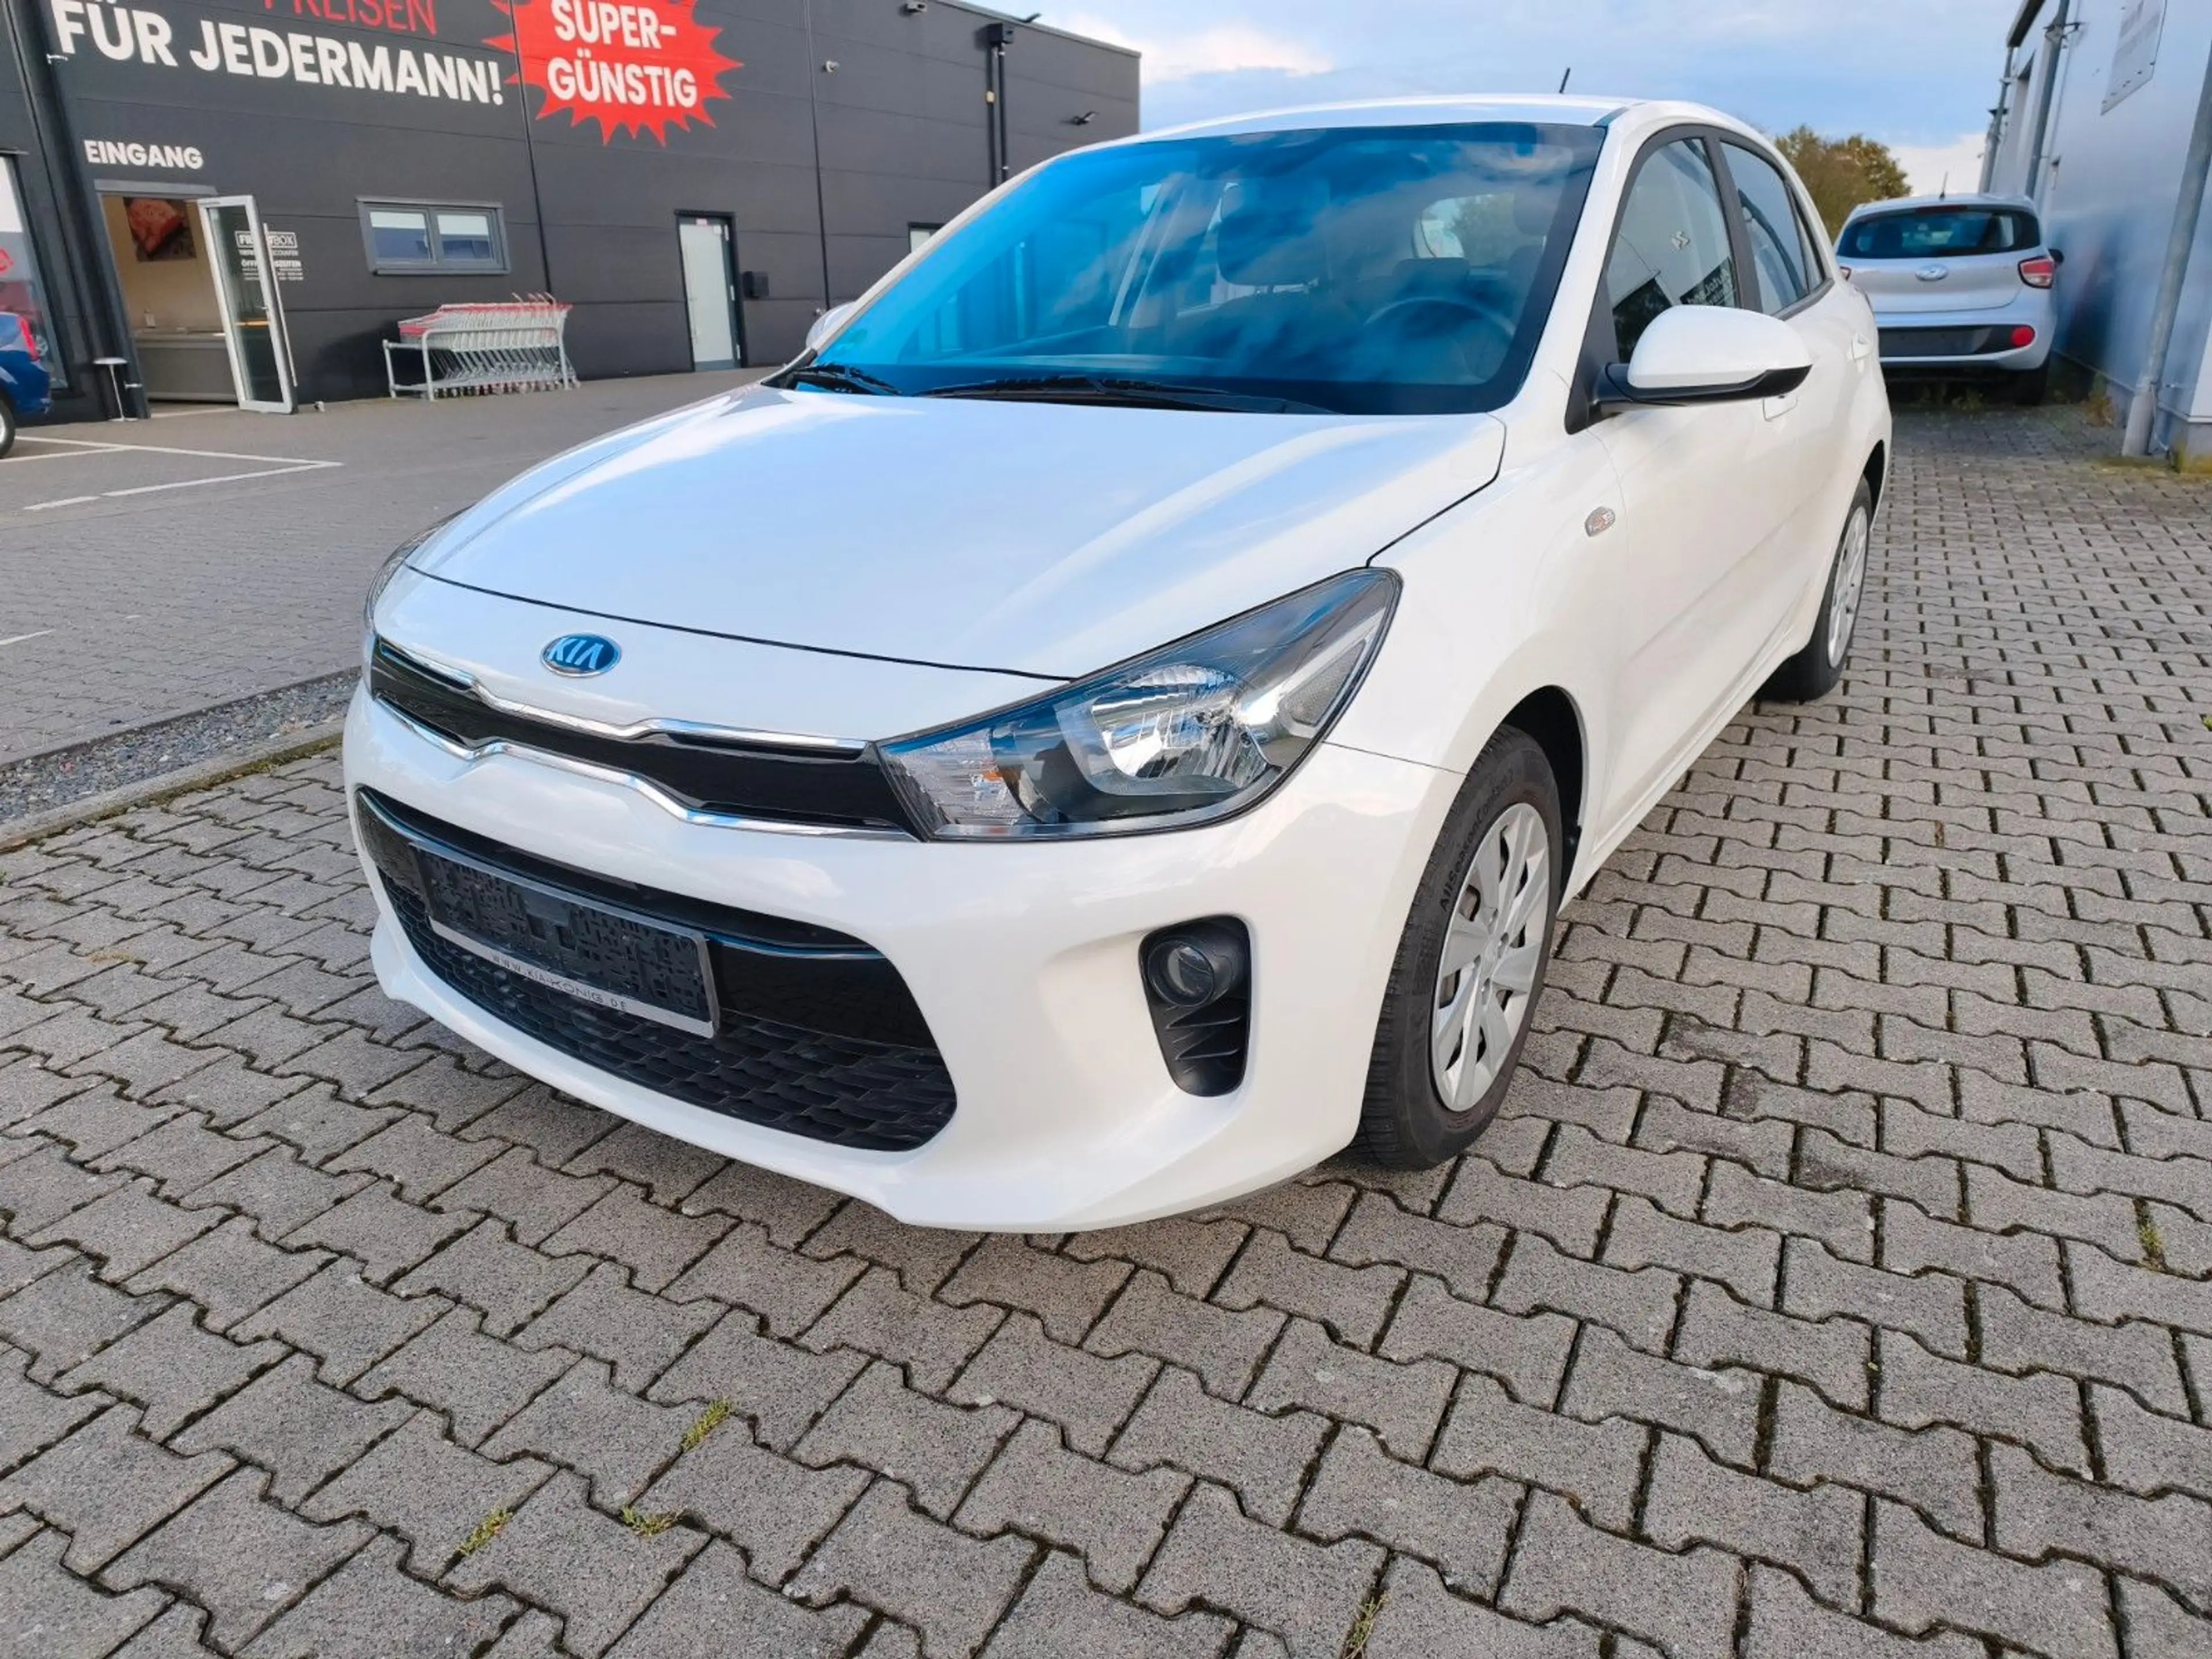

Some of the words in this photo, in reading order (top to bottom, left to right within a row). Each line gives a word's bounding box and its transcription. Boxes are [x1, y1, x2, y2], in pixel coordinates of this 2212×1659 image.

[551, 0, 677, 49] SUPER-
[51, 0, 179, 67] FÜR
[190, 20, 503, 105] JEDERMANN!
[547, 48, 698, 108] GÜNSTIG
[84, 139, 204, 169] EINGANG
[548, 637, 604, 669] KIA
